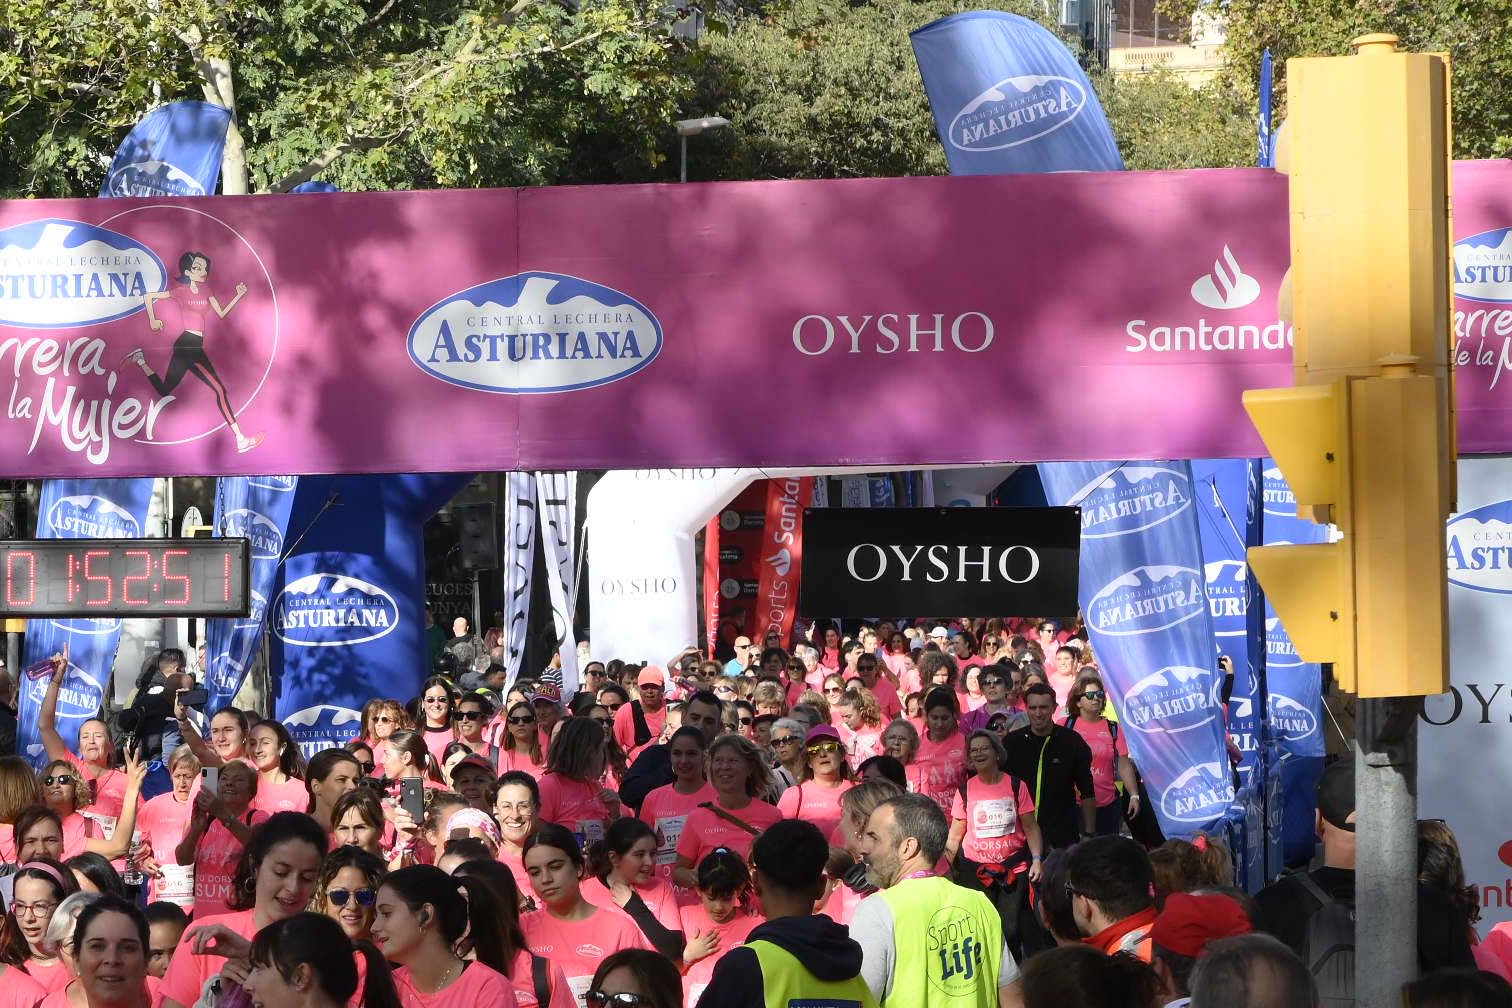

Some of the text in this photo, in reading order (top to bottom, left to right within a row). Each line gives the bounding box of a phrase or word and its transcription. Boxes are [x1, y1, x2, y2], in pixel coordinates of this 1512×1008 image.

[70, 255, 143, 266] LECHERA
[466, 312, 635, 327] CENTRAL LECHERA
[792, 311, 995, 355] OYSHO
[427, 319, 643, 363] ASTURIANA
[8, 380, 33, 419] la
[27, 371, 176, 465] Mujer
[847, 543, 1040, 584] OYSHO
[289, 598, 332, 608] CENTRAL
[601, 576, 677, 597] OYSHO
[277, 602, 389, 629] ASTURIANA
[928, 915, 975, 951] Sport
[939, 937, 983, 981] Life
